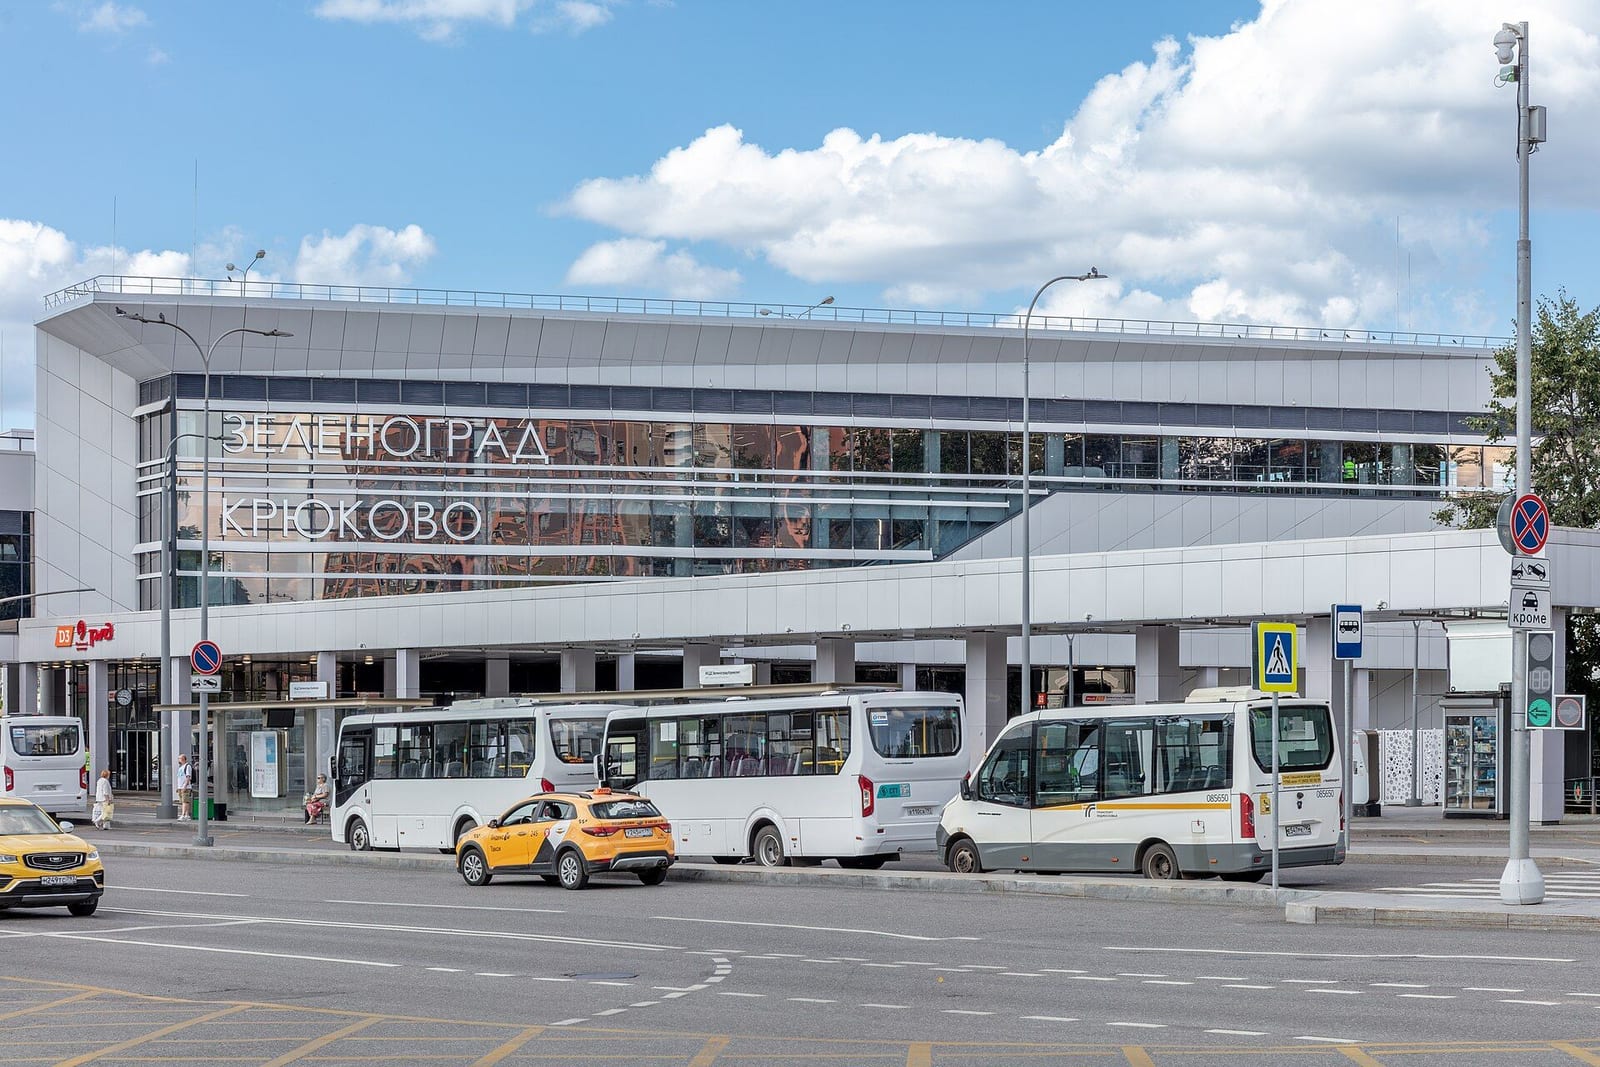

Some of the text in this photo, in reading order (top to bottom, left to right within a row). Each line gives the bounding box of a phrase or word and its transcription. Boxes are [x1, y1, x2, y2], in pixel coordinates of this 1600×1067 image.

[222, 414, 550, 465] ЗЕЛЕНОГРАД
[222, 497, 482, 541] КРЮКОВО
[1513, 612, 1547, 626] кроме
[58, 629, 70, 643] D3
[1206, 793, 1229, 803] 085650
[1316, 789, 1335, 799] 085650
